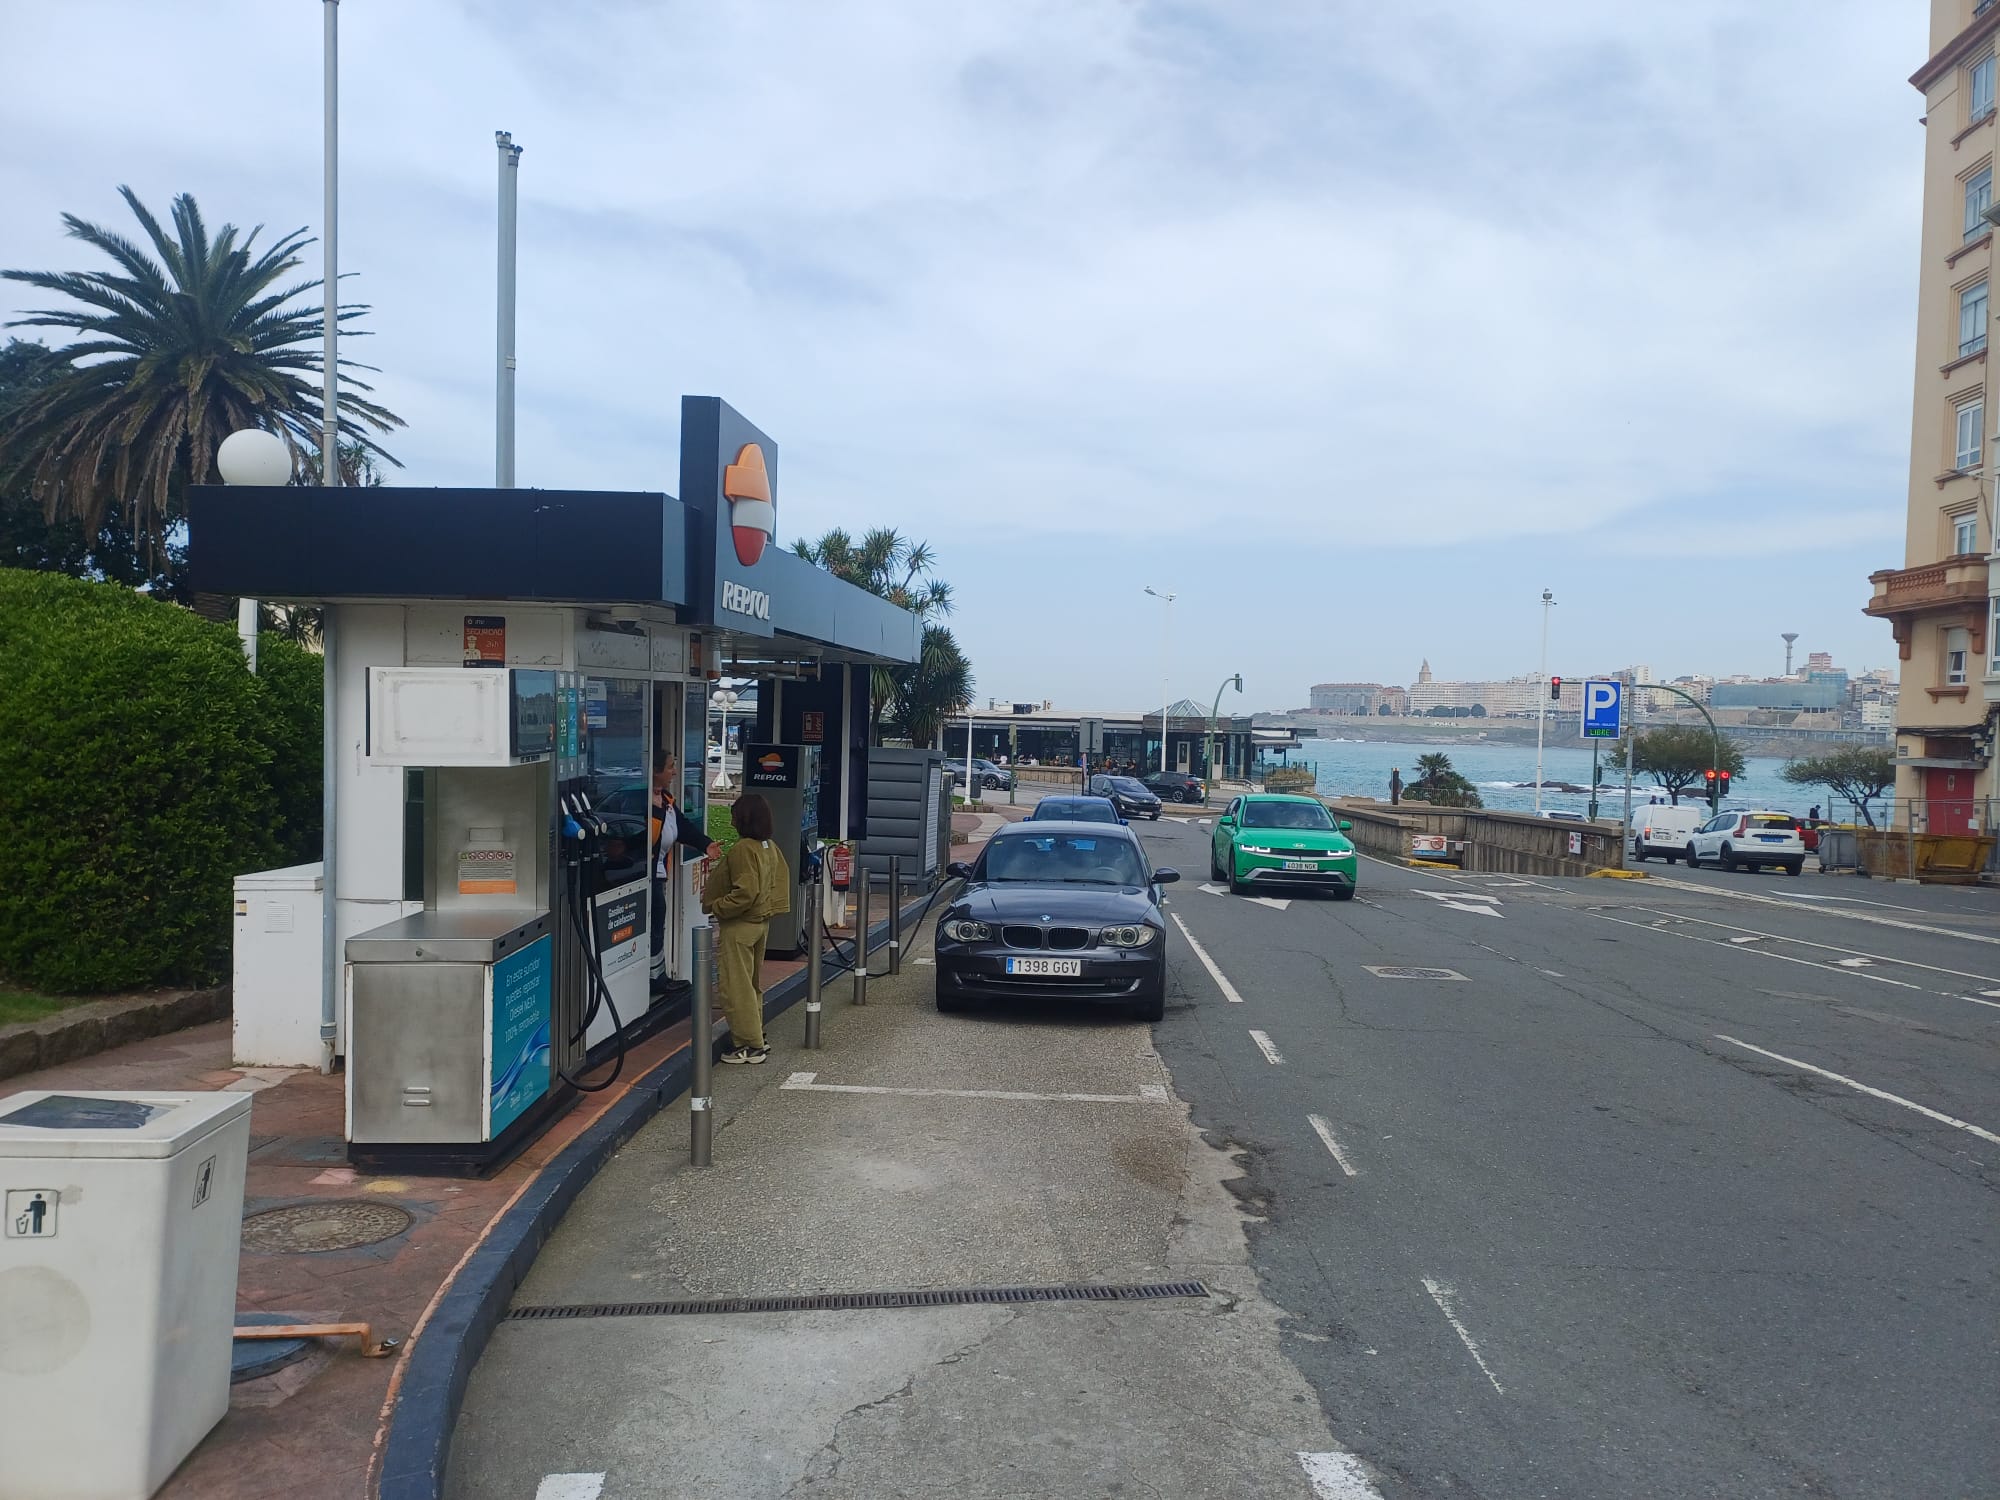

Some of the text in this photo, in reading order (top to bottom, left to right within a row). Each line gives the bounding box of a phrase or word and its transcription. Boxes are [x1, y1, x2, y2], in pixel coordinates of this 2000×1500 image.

[722, 580, 770, 620] REPSOL
[1588, 684, 1617, 720] P
[753, 773, 787, 781] REPSOL
[506, 957, 541, 987] En este surtidor
[1017, 960, 1078, 974] 1398 GGV
[506, 975, 541, 1006] puedes repostar
[505, 1024, 518, 1043] 100%
